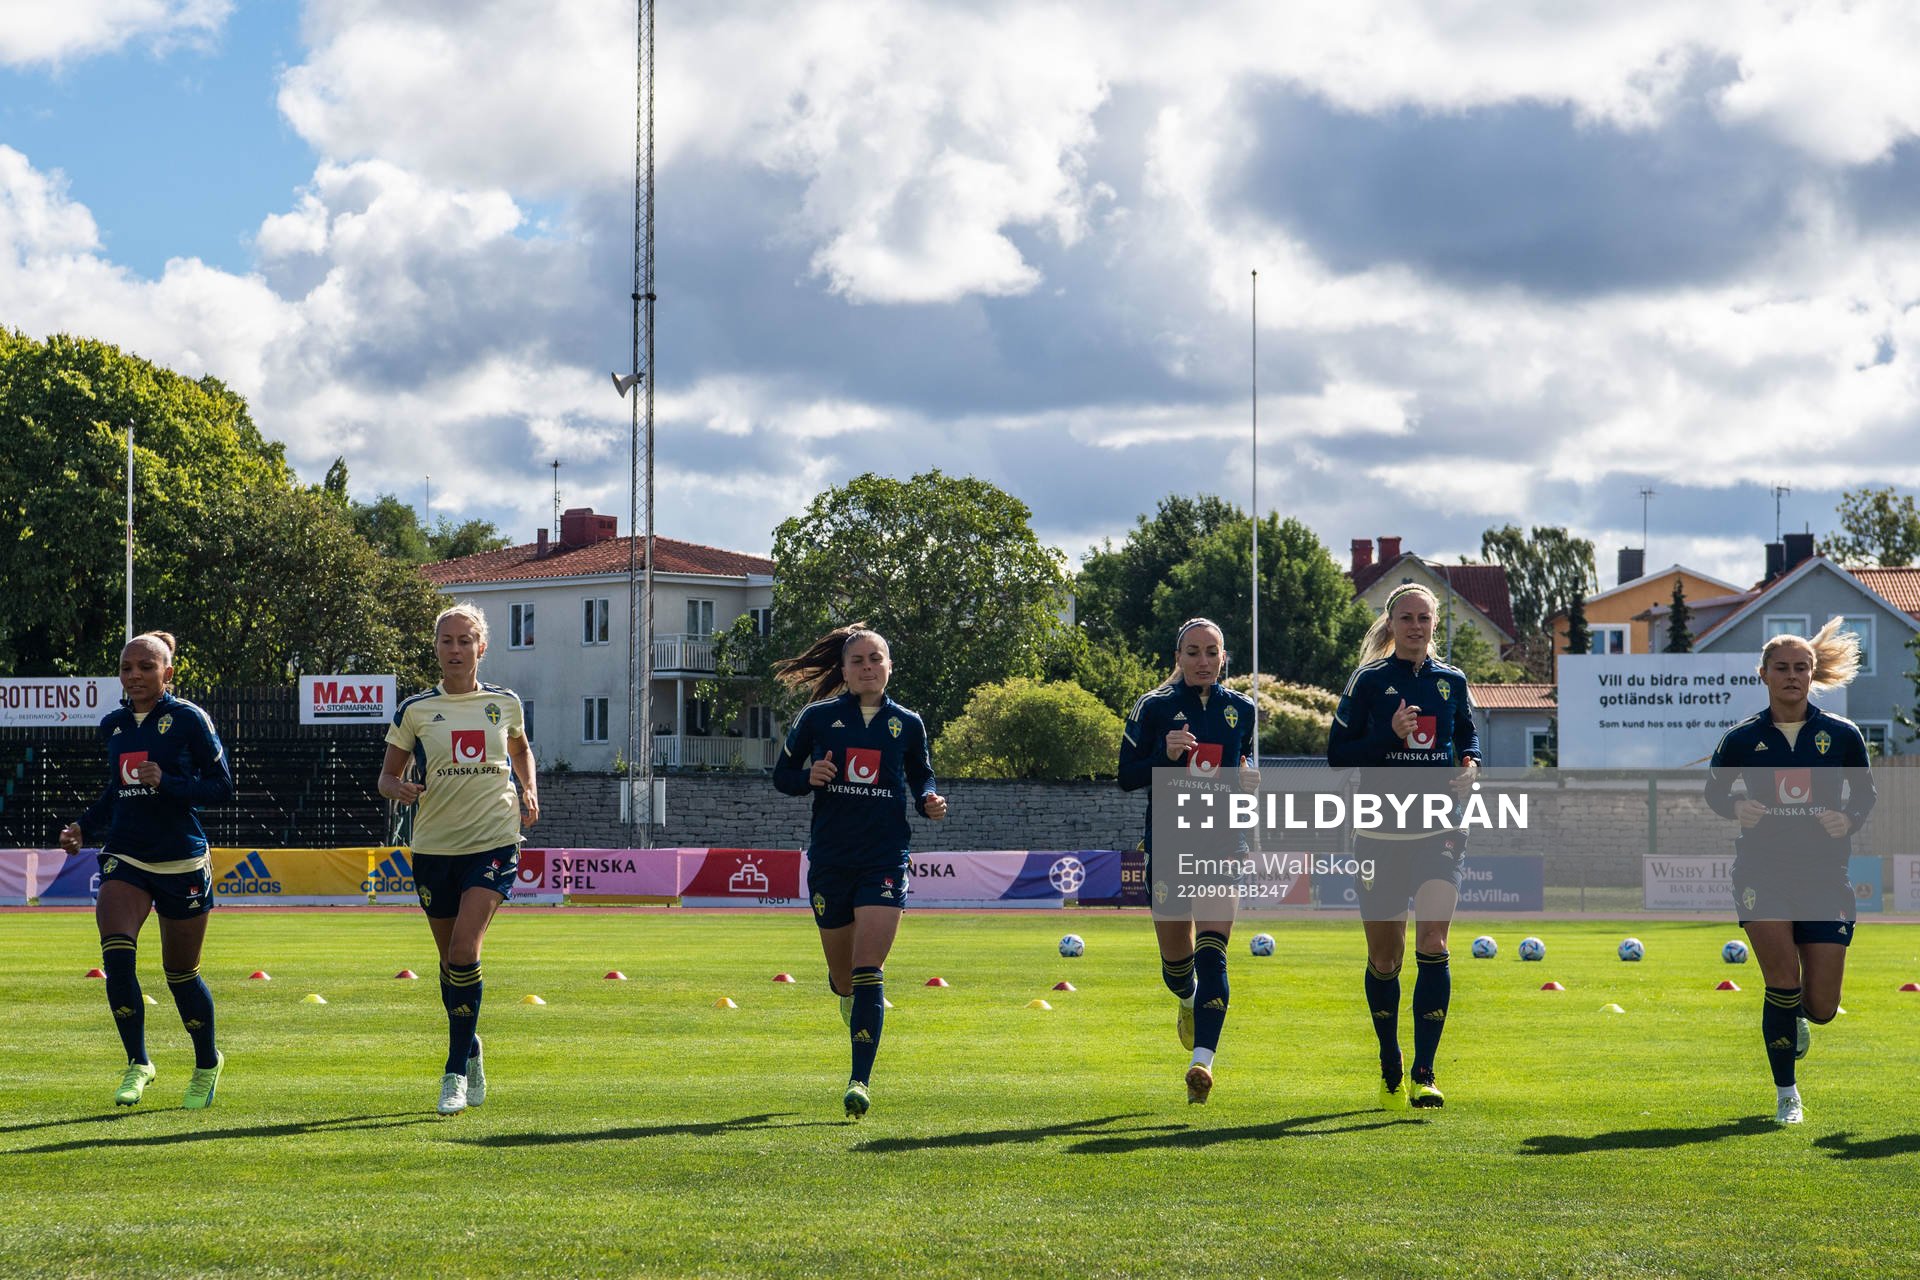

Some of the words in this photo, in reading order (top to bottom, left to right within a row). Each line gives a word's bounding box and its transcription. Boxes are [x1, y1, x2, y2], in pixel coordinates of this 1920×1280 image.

[1598, 674, 1622, 686] Vill
[1627, 674, 1645, 686] du
[1651, 674, 1688, 686] bidra
[1694, 673, 1725, 686] med
[86, 681, 97, 708] Ö
[313, 682, 384, 704] MAXI
[1600, 692, 1673, 708] gotländsk
[1679, 692, 1731, 704] idrott?
[1600, 720, 1620, 728] Som
[1622, 719, 1645, 728] kund
[1648, 720, 1664, 728] hos
[1704, 719, 1716, 728] du
[437, 767, 479, 777] SVENSKA
[480, 766, 502, 775] SPEL
[826, 784, 869, 796] SVENSKA
[871, 788, 894, 798] SPEL
[552, 858, 637, 873] SVENSKA
[217, 877, 281, 894] adidas
[552, 875, 597, 890] SPEL
